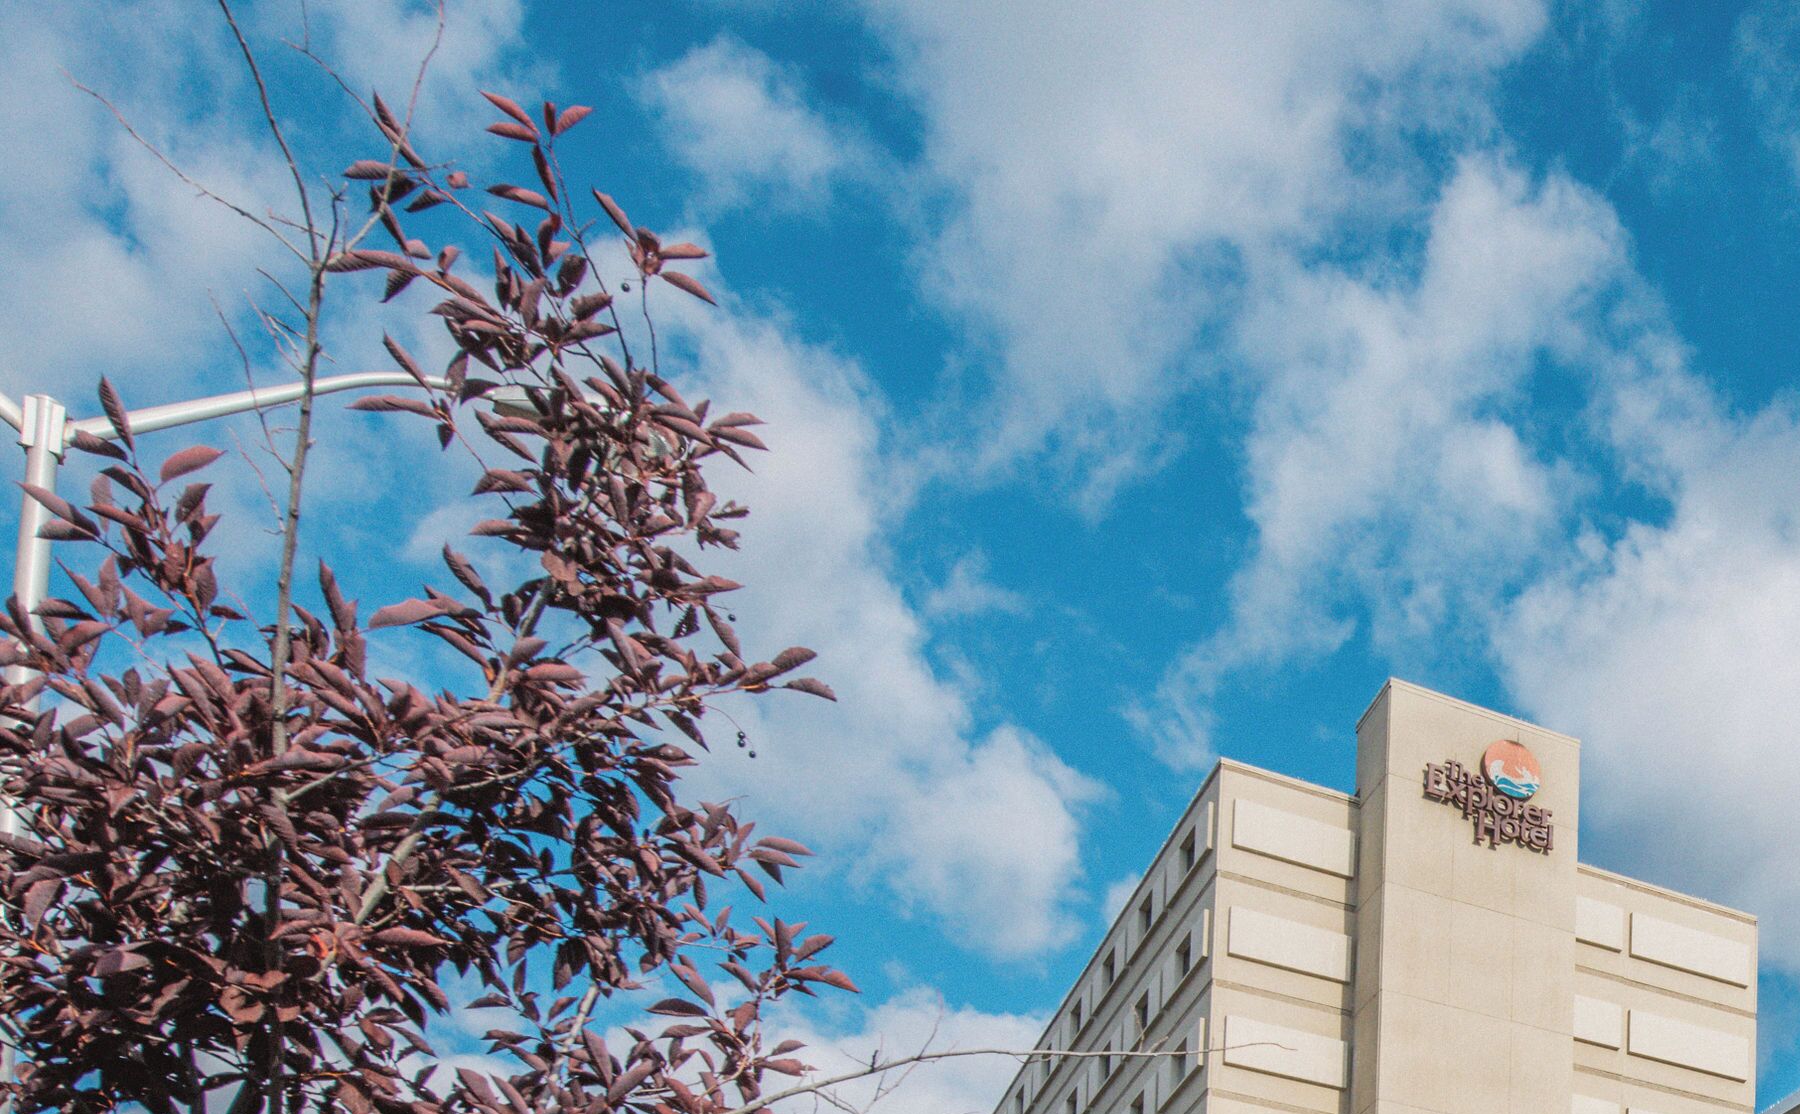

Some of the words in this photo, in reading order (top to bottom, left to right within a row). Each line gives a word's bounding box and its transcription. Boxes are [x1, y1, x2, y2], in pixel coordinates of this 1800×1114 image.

[1445, 758, 1486, 788] The
[1425, 762, 1553, 829] Explorer
[1476, 809, 1554, 851] Hotel
